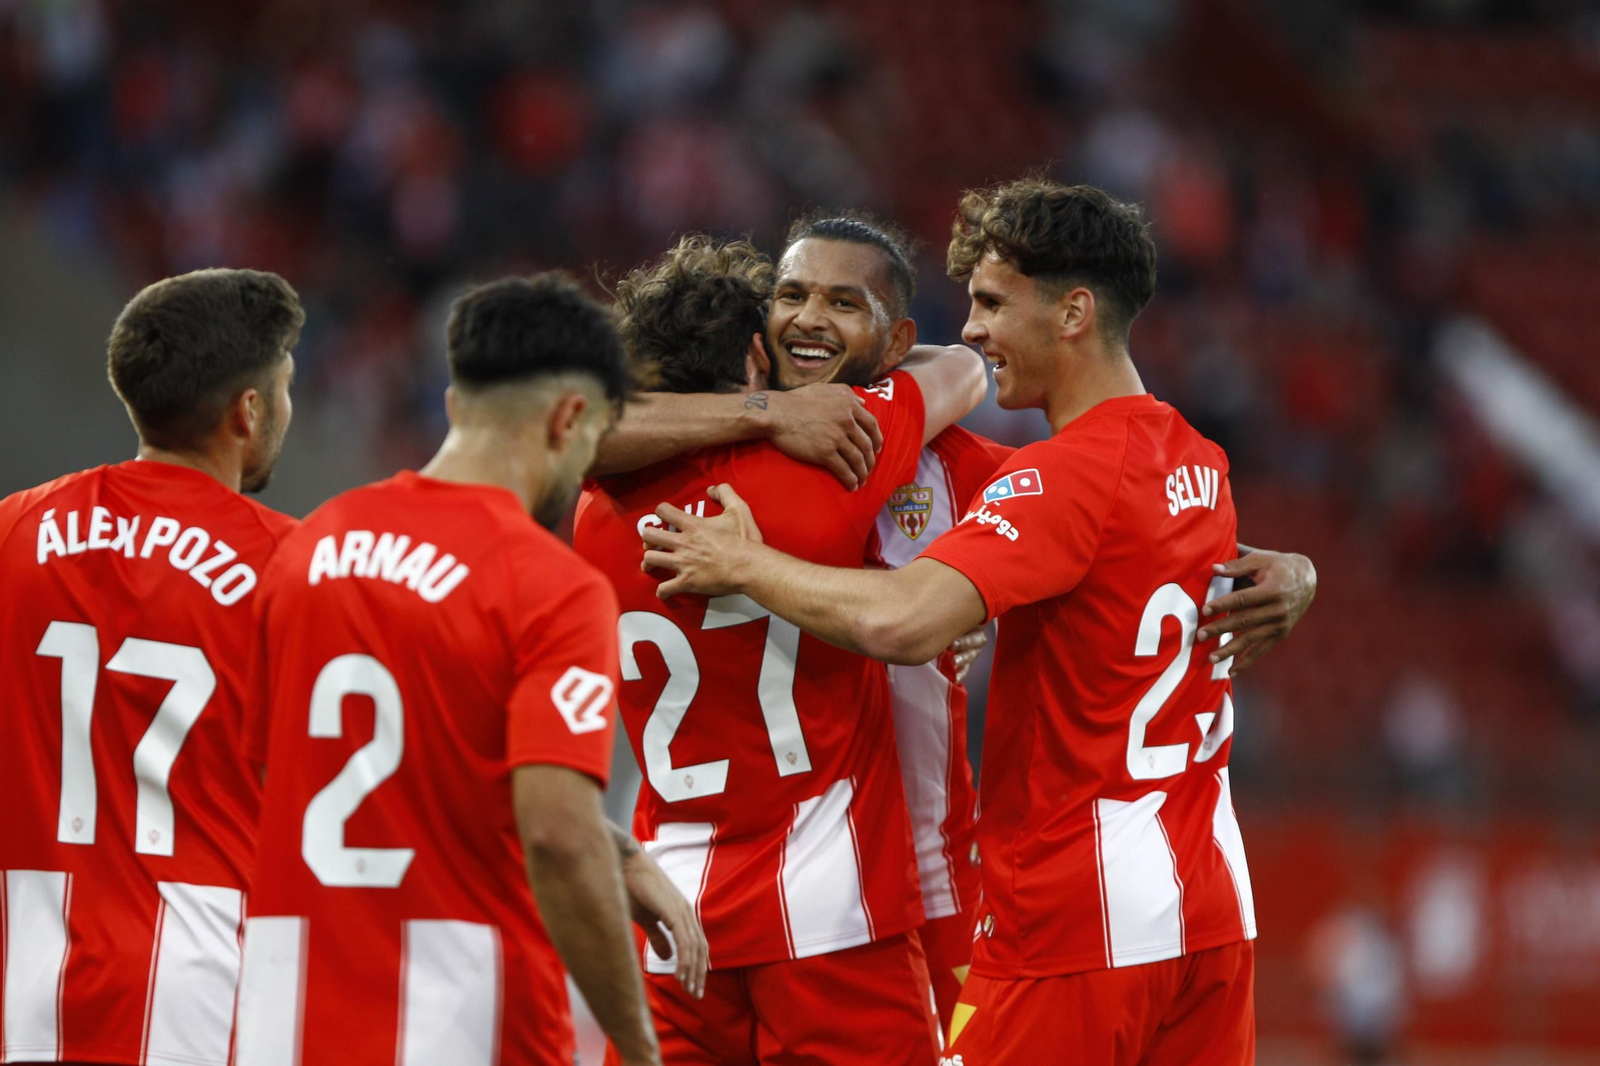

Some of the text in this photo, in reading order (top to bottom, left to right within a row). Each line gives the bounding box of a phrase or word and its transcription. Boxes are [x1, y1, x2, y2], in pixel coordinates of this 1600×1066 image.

[37, 507, 257, 606] ÁLEX POZO
[308, 530, 469, 602] ARNAU
[1165, 464, 1219, 517] SELVI
[35, 620, 217, 857] 17
[301, 653, 416, 888] 2
[617, 593, 812, 803] 27
